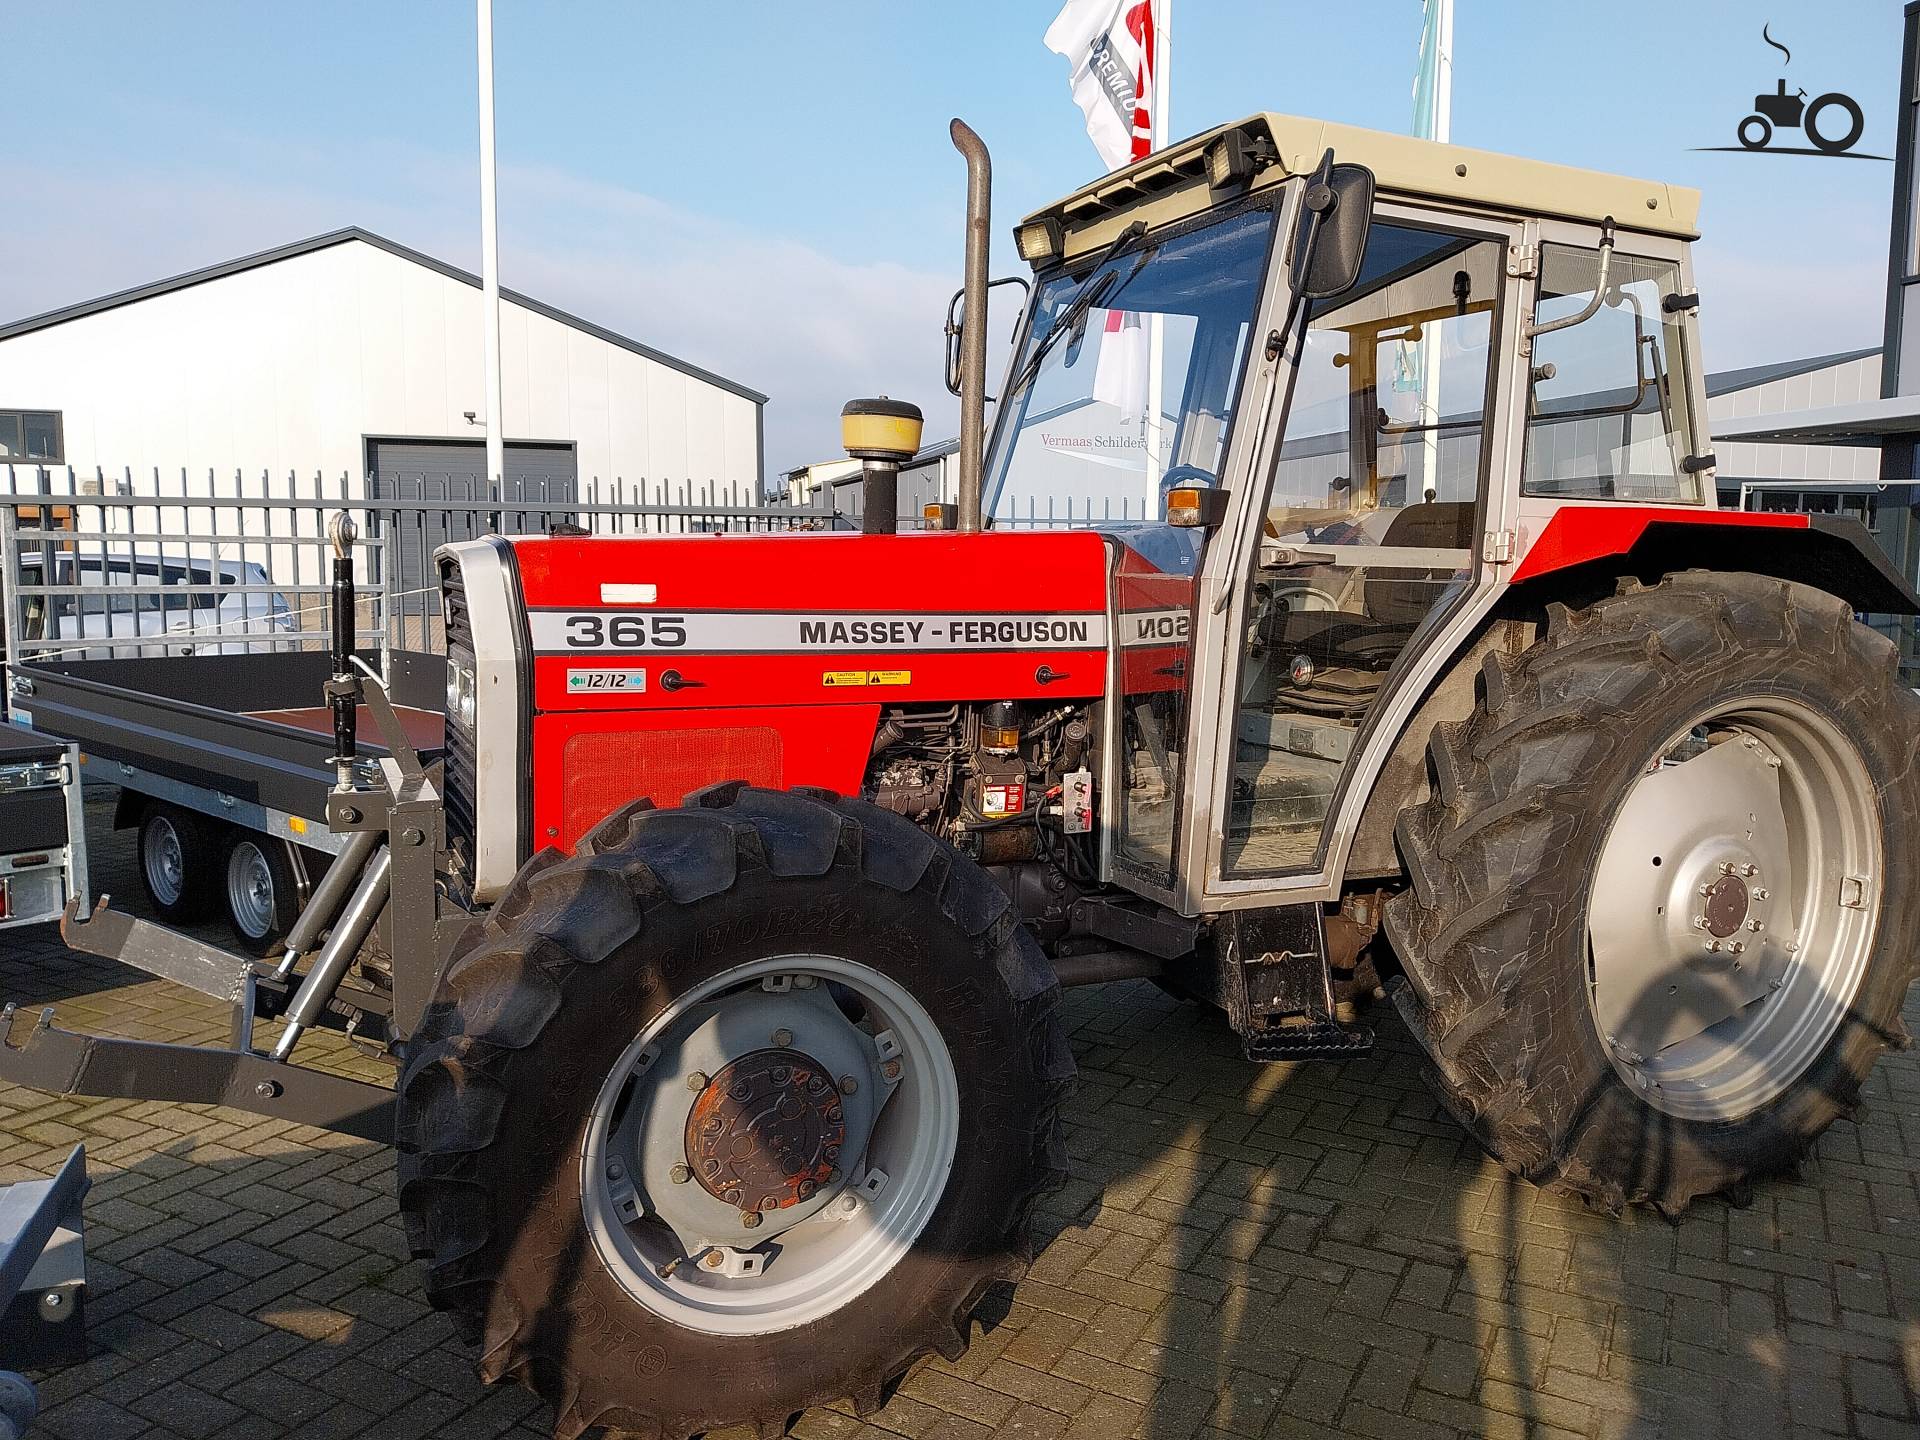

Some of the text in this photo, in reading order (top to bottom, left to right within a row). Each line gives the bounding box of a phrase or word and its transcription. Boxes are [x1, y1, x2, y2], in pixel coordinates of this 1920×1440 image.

[1041, 433, 1093, 448] Vermaas
[566, 616, 687, 647] 365
[799, 621, 924, 644] MASSEY
[949, 620, 1088, 643] FERGUSON
[587, 673, 627, 688] 12/12
